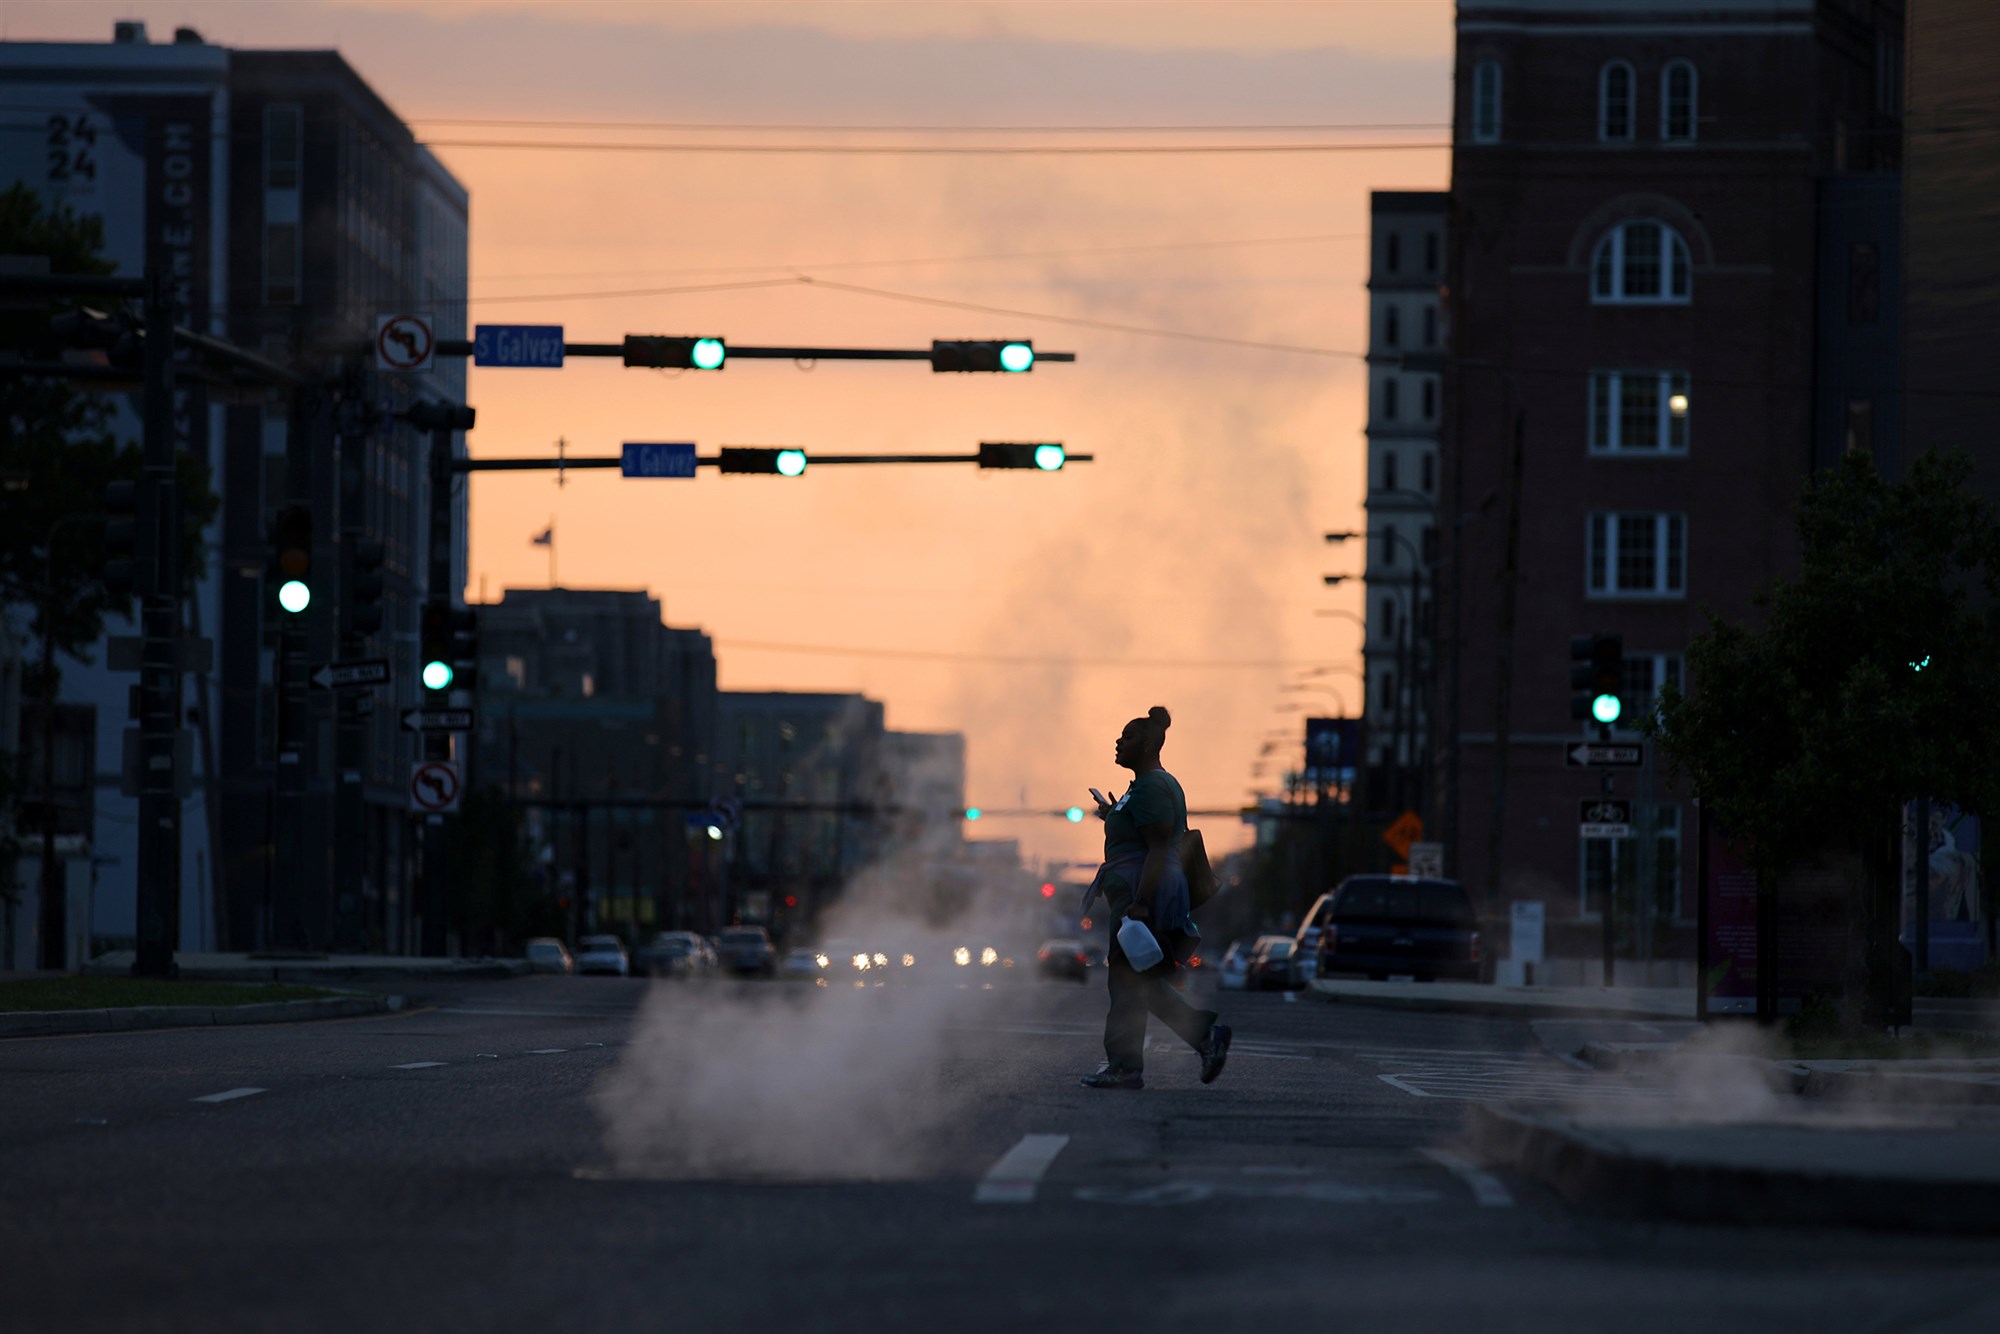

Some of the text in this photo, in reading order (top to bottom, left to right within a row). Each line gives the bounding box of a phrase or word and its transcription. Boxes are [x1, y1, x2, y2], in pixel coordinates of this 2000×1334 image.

[48, 114, 96, 147] 24
[47, 149, 96, 181] 24
[477, 328, 561, 363] S Galvez
[625, 446, 691, 475] S Galvez
[334, 665, 380, 682] ONE WAY
[422, 713, 467, 726] ONE WAY
[1590, 749, 1636, 761] ONE WAY
